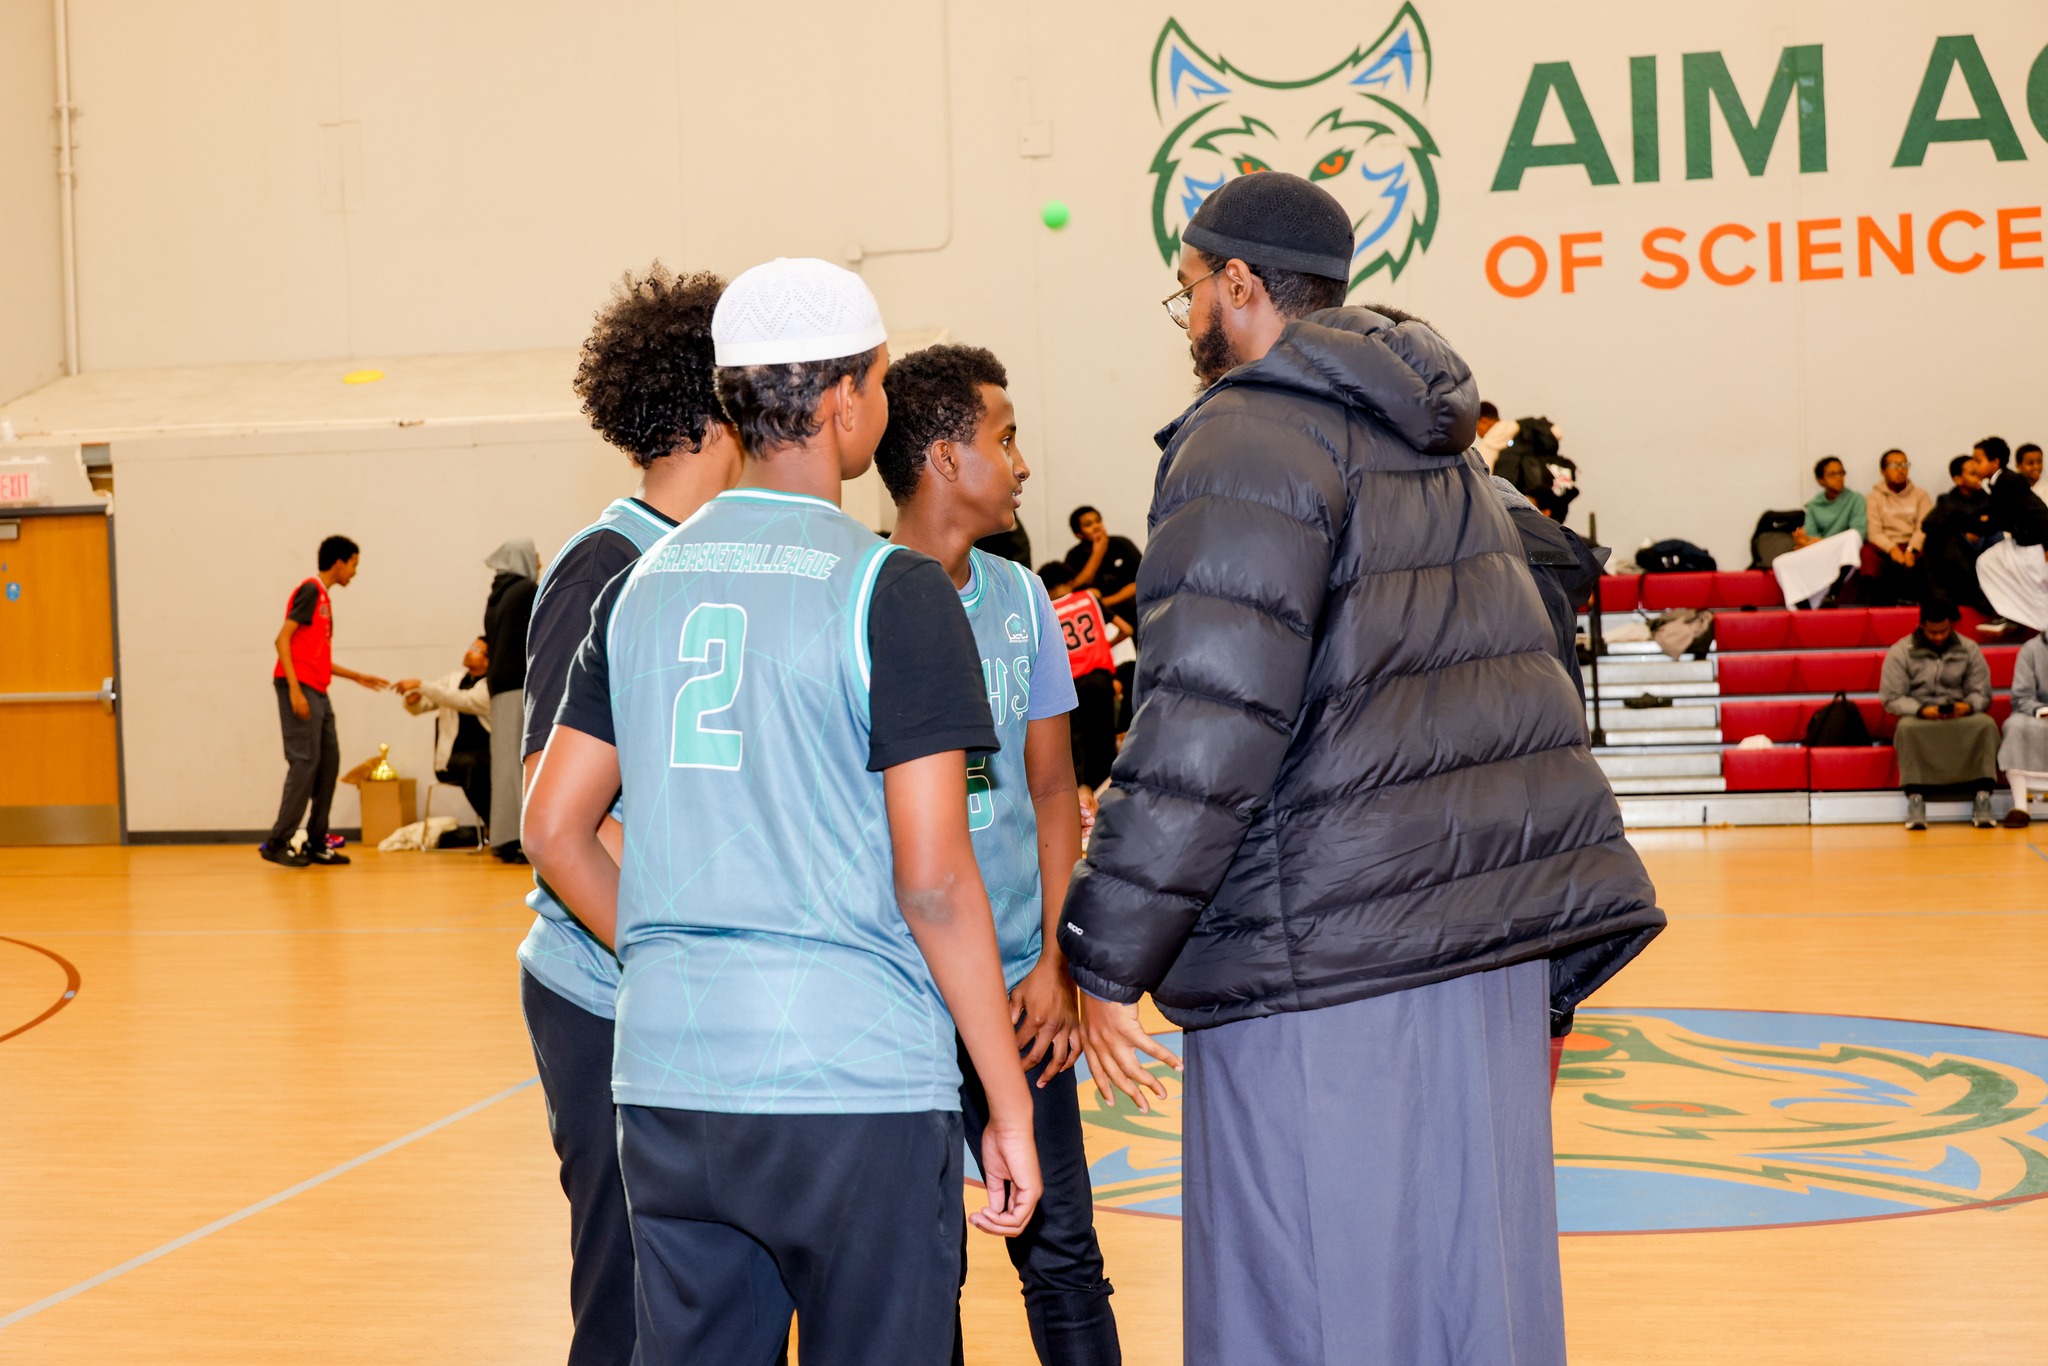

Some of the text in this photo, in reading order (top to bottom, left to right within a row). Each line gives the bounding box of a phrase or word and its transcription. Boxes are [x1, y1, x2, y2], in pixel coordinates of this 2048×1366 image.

[1489, 34, 2048, 192] AIM A
[1484, 206, 2044, 298] OF SCIENCE
[0, 474, 28, 500] EXIT
[1060, 613, 1095, 650] 32
[670, 602, 747, 771] 2
